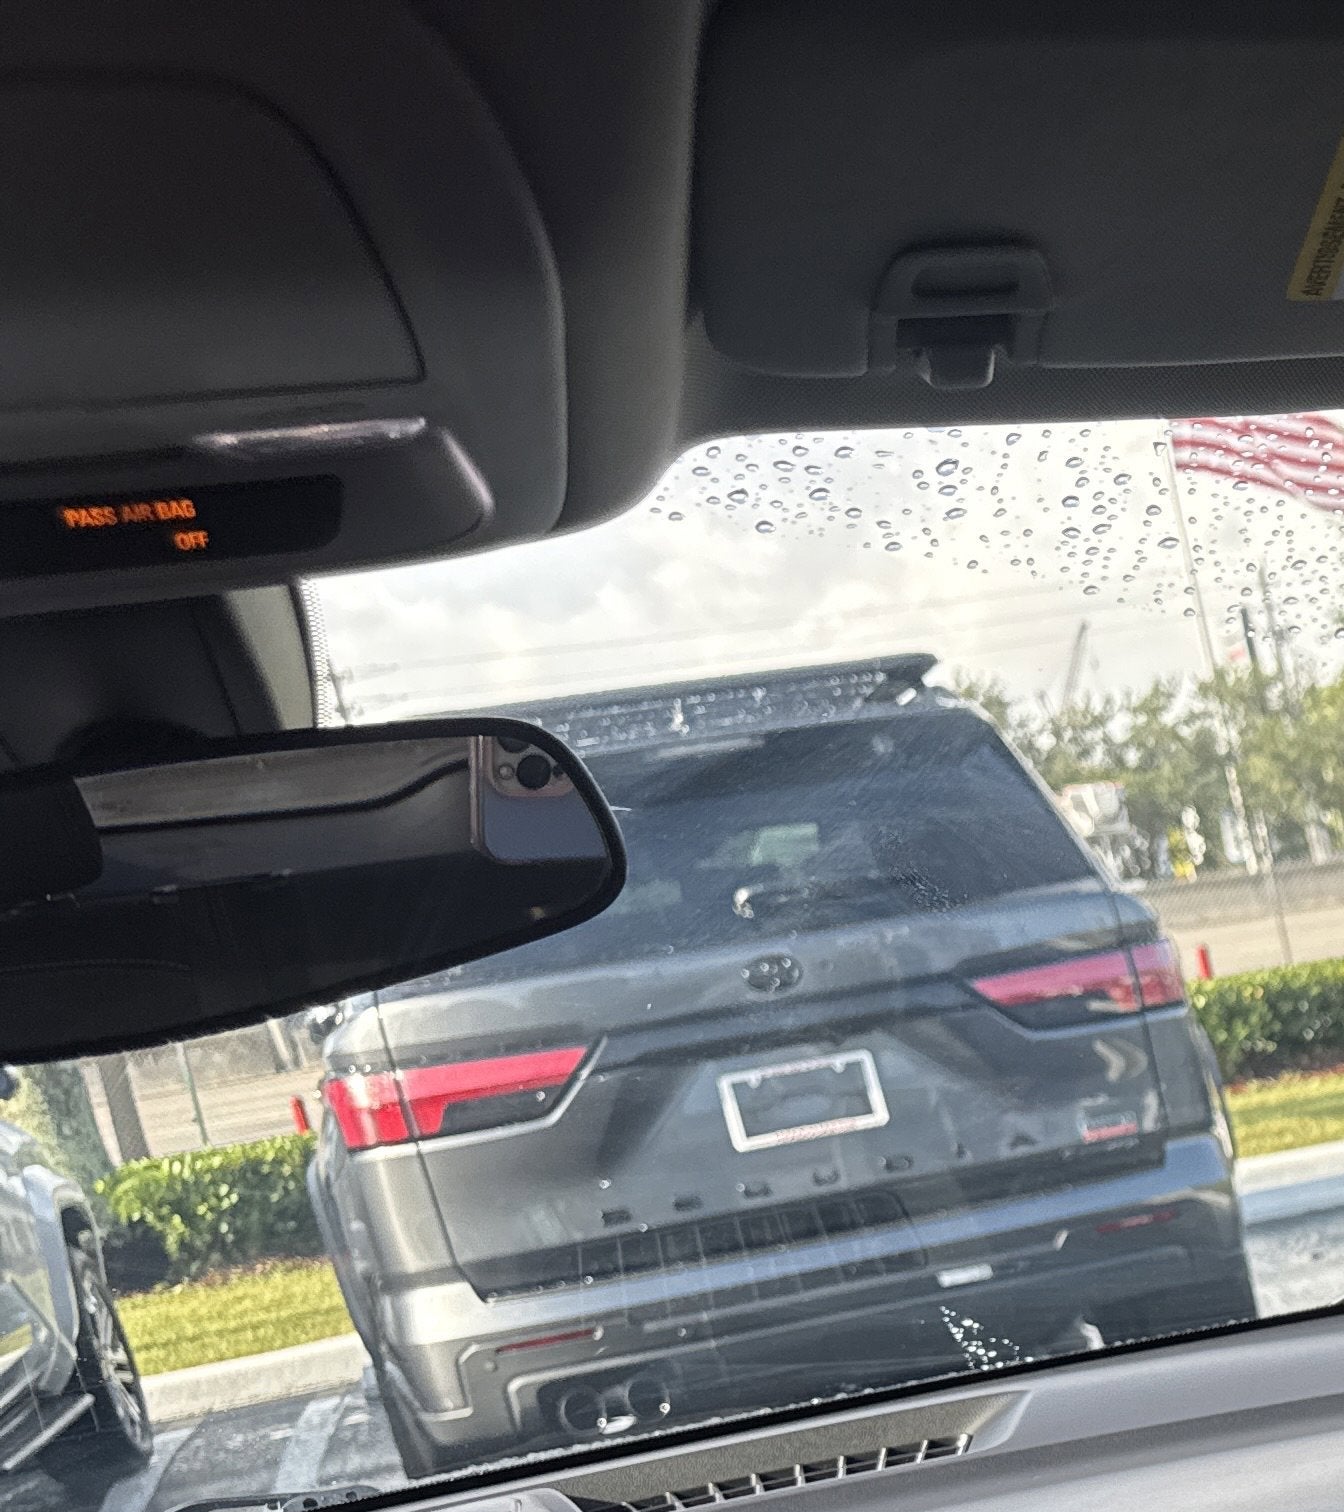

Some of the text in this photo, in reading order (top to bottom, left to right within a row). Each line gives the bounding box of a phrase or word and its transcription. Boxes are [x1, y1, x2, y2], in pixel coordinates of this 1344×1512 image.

[63, 499, 197, 528] PASS AIR BAG
[174, 530, 209, 552] OFF
